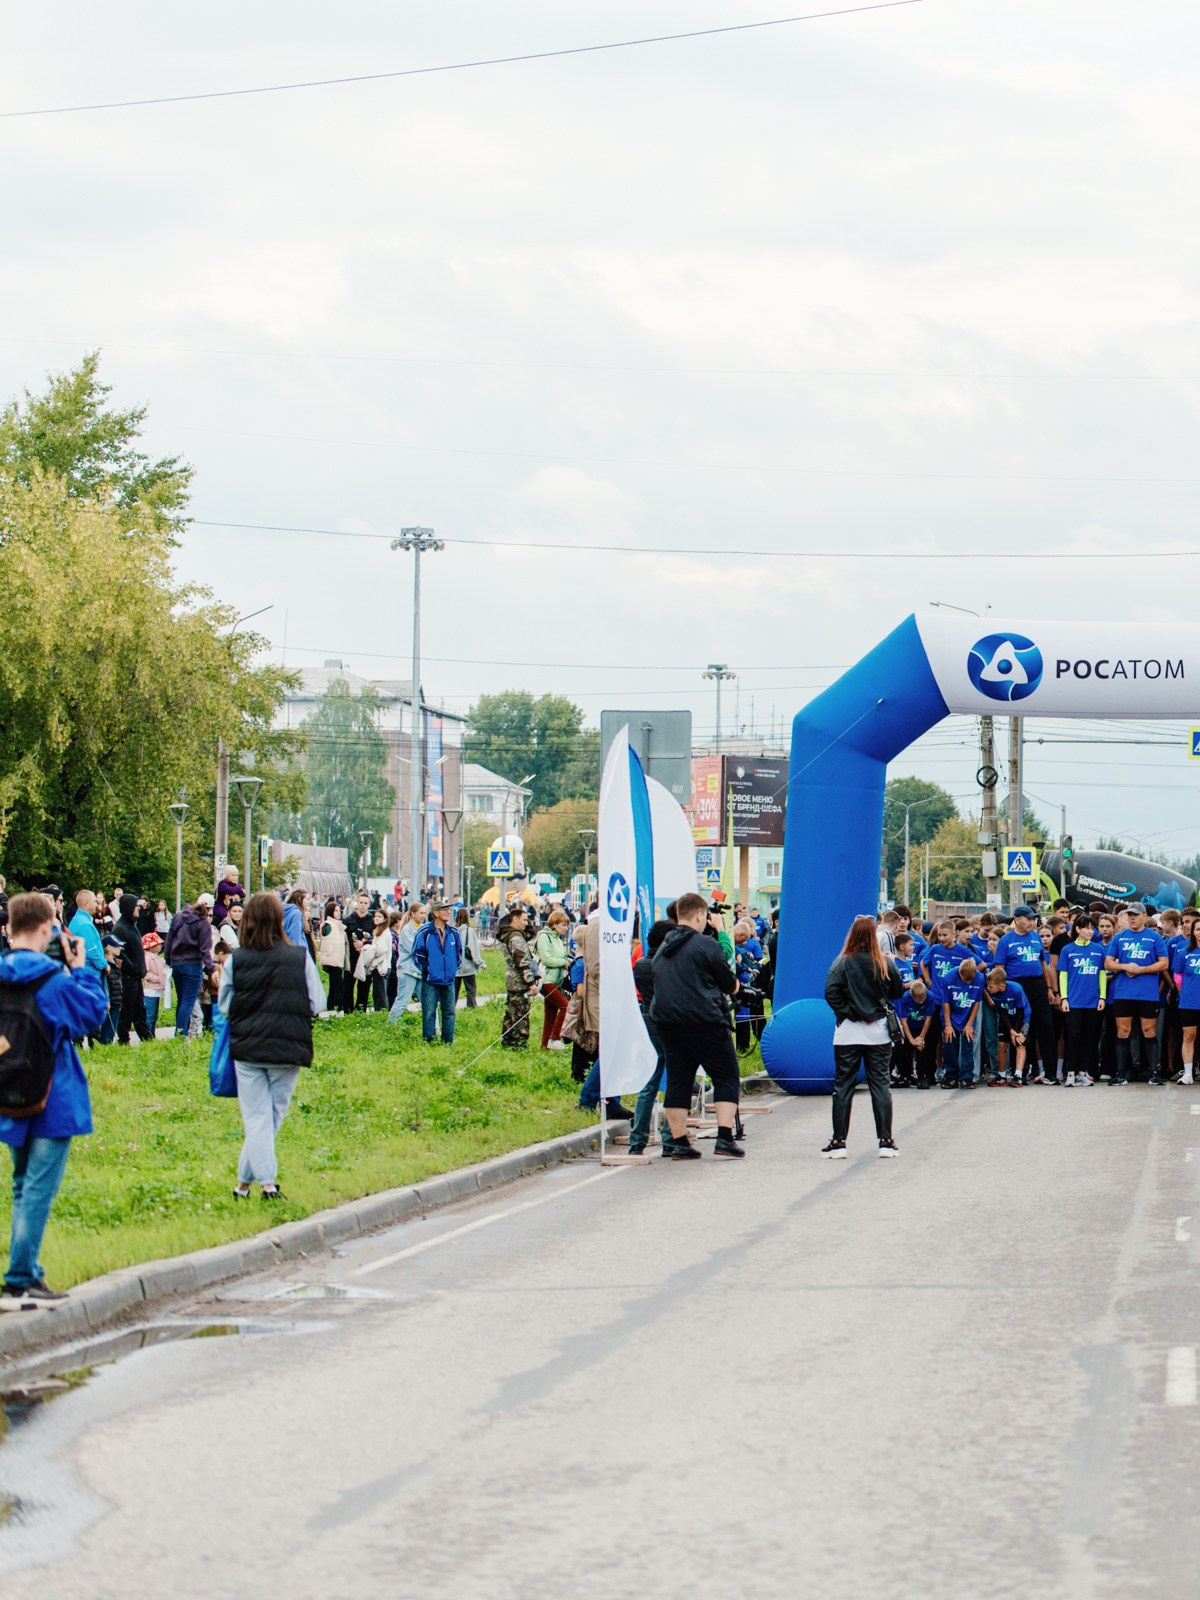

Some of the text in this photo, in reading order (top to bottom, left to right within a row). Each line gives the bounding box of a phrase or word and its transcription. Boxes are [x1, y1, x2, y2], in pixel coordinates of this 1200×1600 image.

[1055, 659, 1185, 680] РОСАТОМ
[752, 795, 773, 804] МЕНЮ
[737, 803, 782, 813] БРЕНД-ШЕФА
